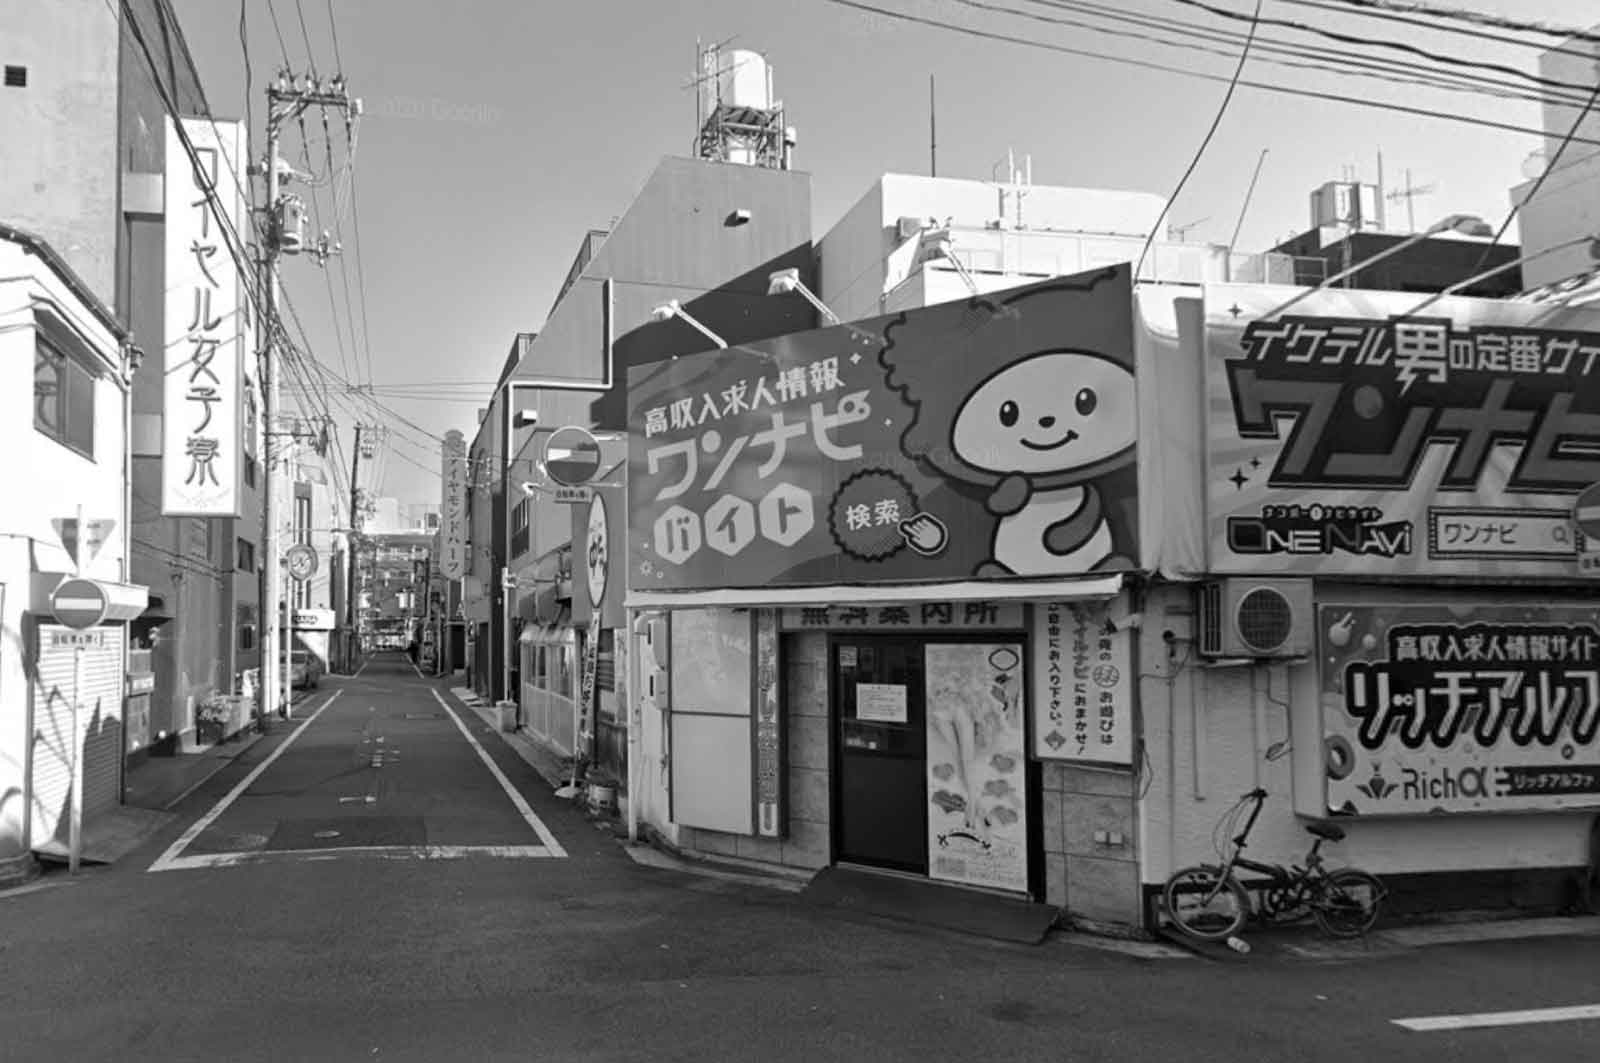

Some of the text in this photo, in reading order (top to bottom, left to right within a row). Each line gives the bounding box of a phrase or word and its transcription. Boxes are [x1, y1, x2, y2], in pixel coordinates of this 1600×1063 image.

[186, 148, 222, 487] ロイヤル女子寮
[645, 356, 845, 439] 高収入求人情報
[648, 390, 870, 500] ワンナビ
[658, 490, 808, 559] バイト
[846, 499, 900, 531] 検索
[1444, 523, 1518, 545] ワンナビ
[1397, 633, 1598, 661] 高収入求人情報サイト
